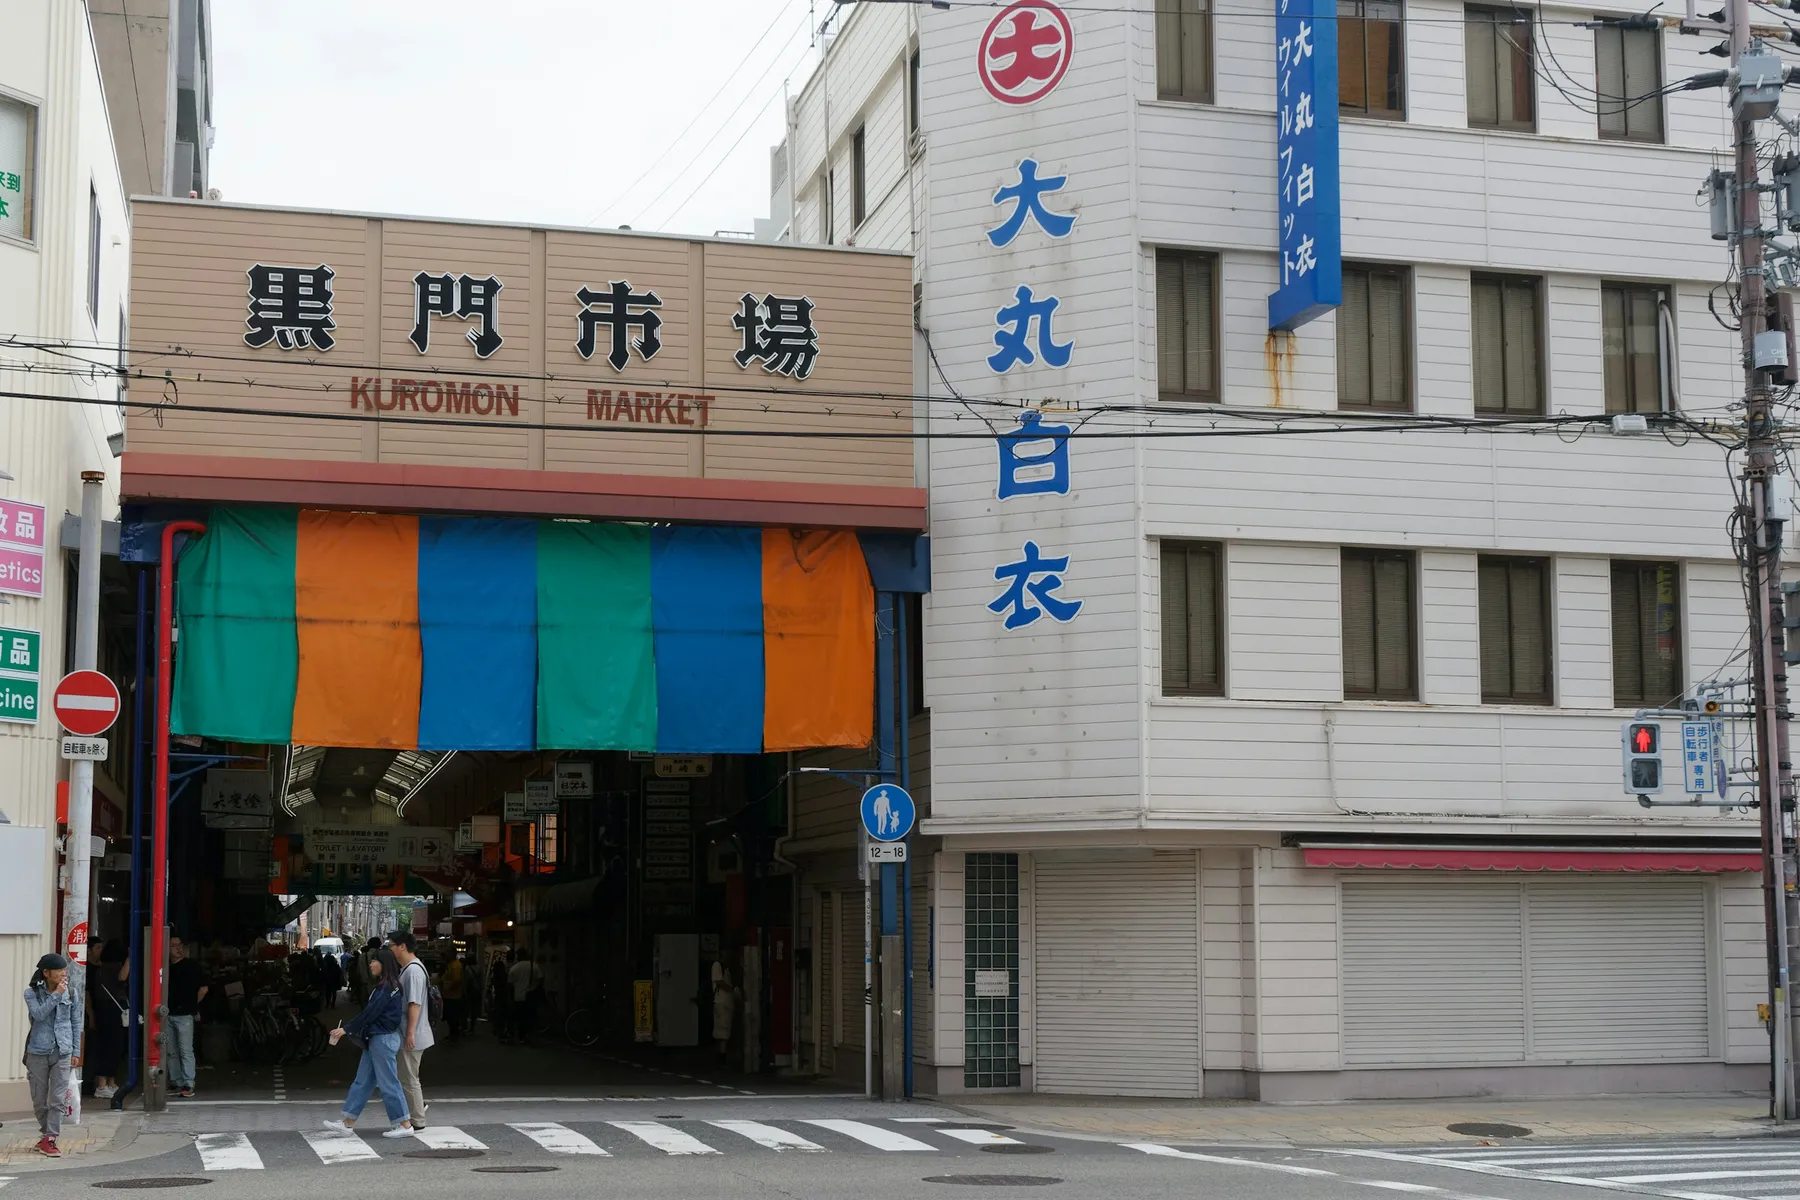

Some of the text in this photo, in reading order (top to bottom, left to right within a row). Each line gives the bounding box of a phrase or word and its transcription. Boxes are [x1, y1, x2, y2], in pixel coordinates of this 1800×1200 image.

[1292, 20, 1317, 278] 大丸白衣
[243, 262, 821, 381] 黒門市場
[350, 376, 716, 427] KUROMON MARKET
[985, 157, 1085, 632] 大丸白衣
[63, 742, 106, 756] 自転車を除く
[1685, 726, 1697, 762] 自転車
[1697, 726, 1708, 762] 歩行者
[346, 844, 387, 853] LAVATORY
